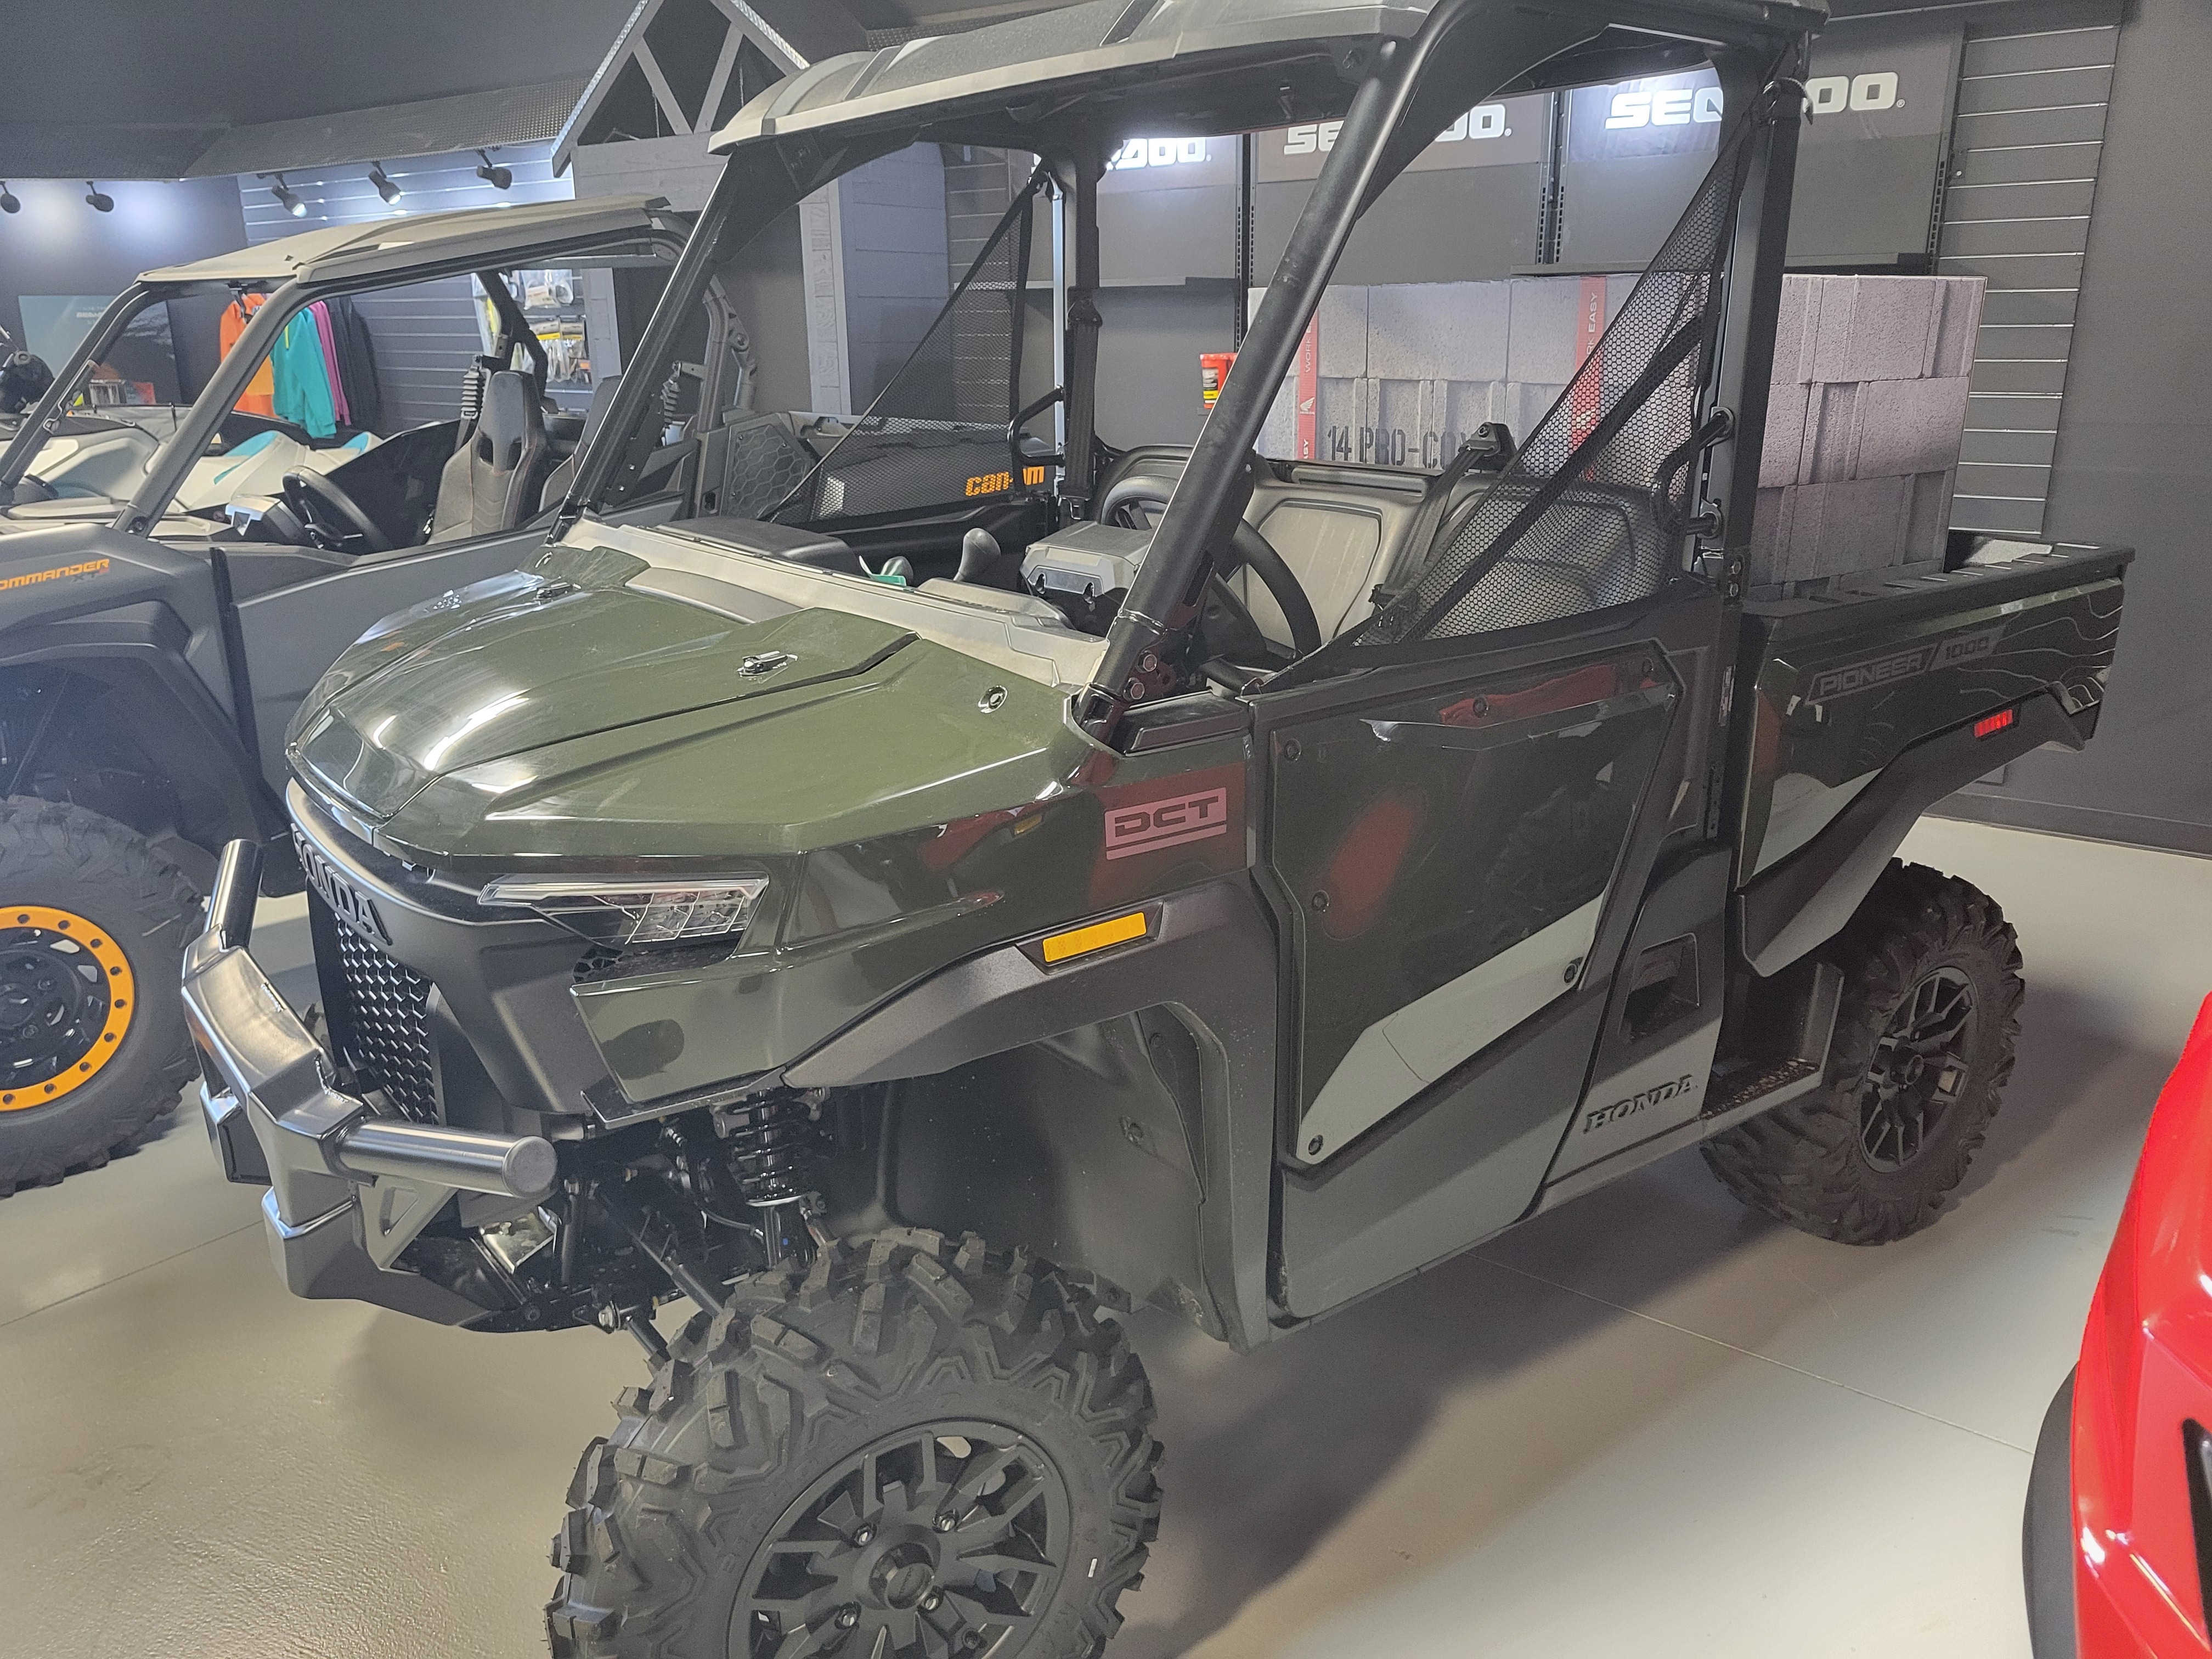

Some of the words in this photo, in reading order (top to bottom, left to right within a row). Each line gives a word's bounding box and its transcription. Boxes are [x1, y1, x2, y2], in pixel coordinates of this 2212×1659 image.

[1588, 292, 1598, 332] EASY
[1328, 425, 1352, 461] 14
[1359, 426, 1468, 469] PRO-CO
[966, 466, 1045, 496] can-m
[0, 558, 110, 591] OMMANDER
[1820, 654, 1922, 696] PIONEER
[1946, 636, 1990, 659] 1000
[1115, 796, 1218, 837] DCT
[291, 823, 389, 940] HONDA
[1583, 1074, 1699, 1135] HONDA
